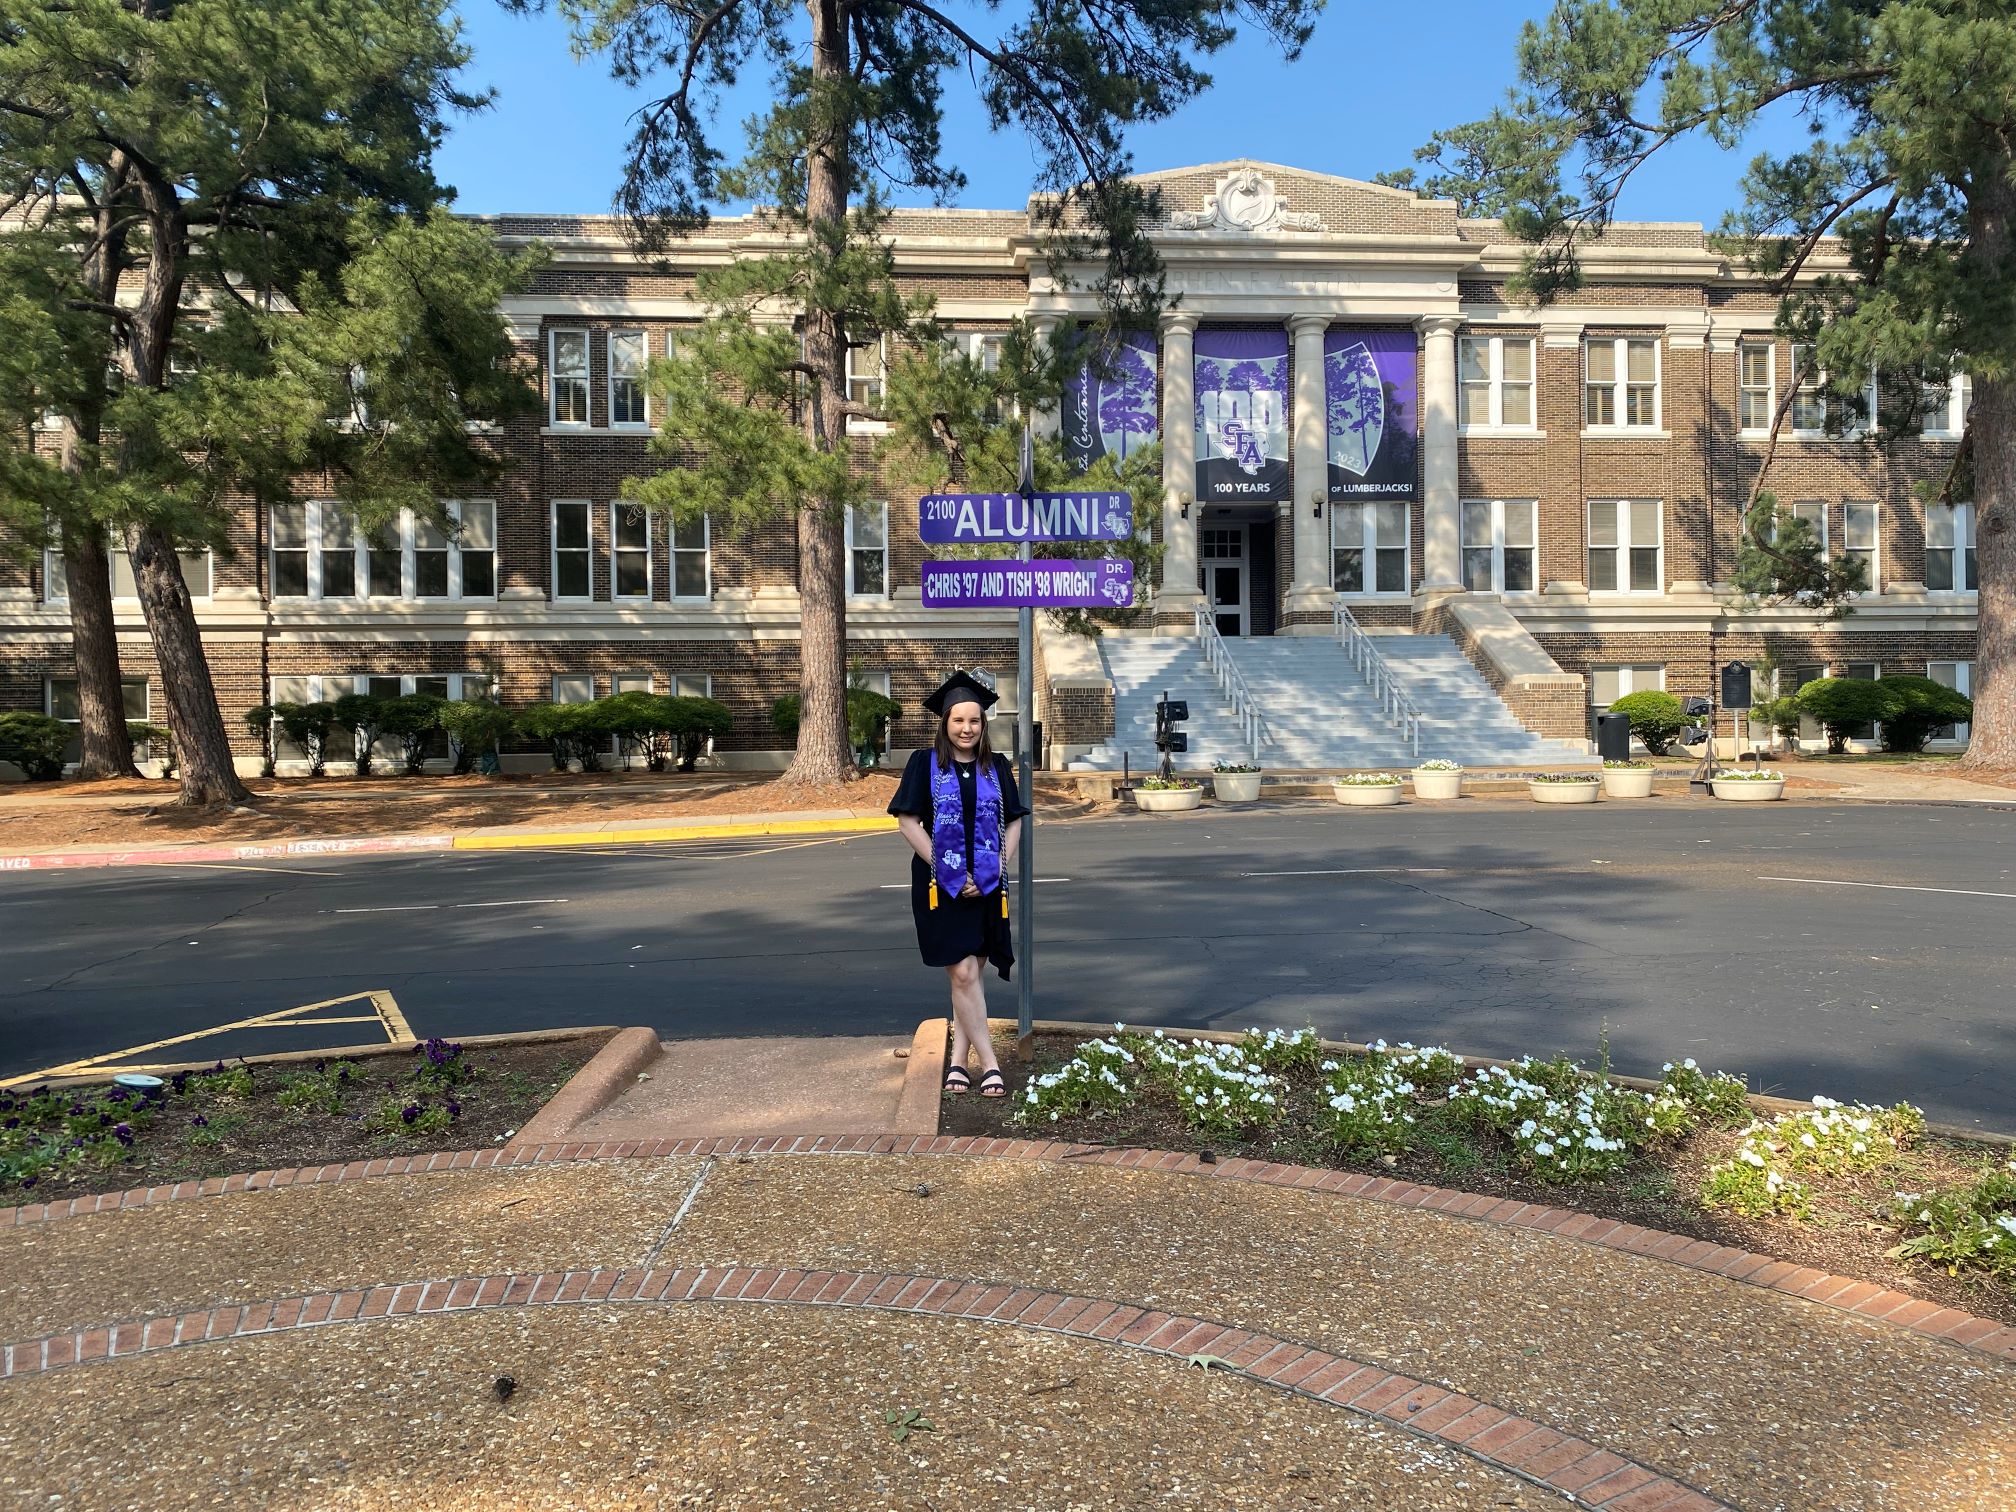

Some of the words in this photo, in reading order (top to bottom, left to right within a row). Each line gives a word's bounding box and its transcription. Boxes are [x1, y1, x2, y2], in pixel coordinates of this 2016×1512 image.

[1172, 271, 1234, 290] PHEN
[1073, 359, 1093, 449] Centennia
[1200, 390, 1283, 434] 100
[1222, 419, 1265, 467] SFA
[1334, 450, 1362, 469] 2023
[1214, 483, 1233, 493] 100
[1235, 483, 1271, 493] YEARS
[1343, 483, 1413, 493] LUMBERJACKS!
[1109, 495, 1120, 509] DR
[927, 500, 956, 520] 2100
[953, 498, 1099, 537] ALUMNI
[1106, 563, 1127, 574] DR.
[927, 572, 961, 598] CHRIS
[980, 571, 1004, 597] AND
[1006, 571, 1032, 597] TISH
[1052, 571, 1097, 597] WRIGHT
